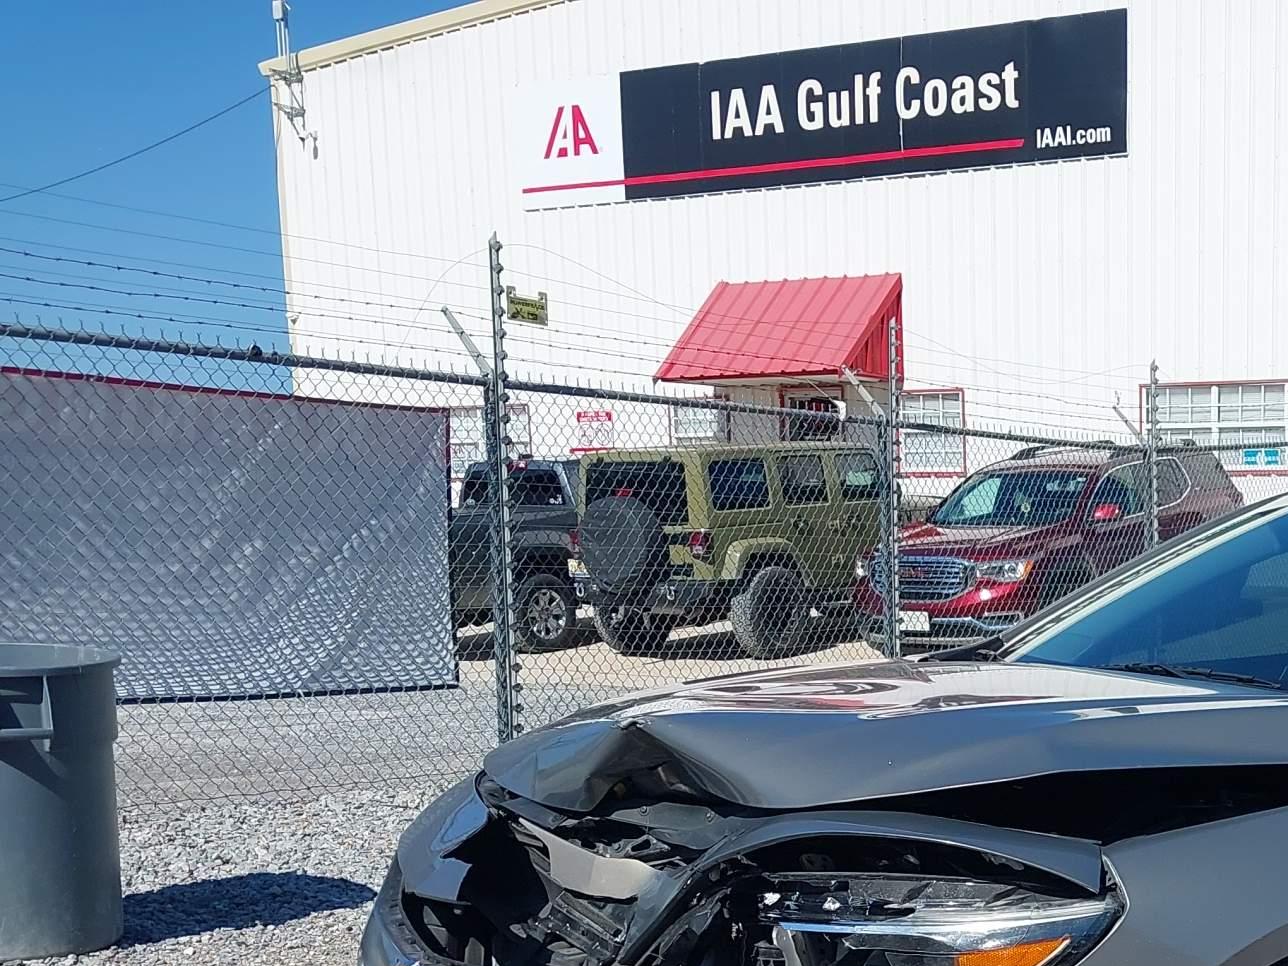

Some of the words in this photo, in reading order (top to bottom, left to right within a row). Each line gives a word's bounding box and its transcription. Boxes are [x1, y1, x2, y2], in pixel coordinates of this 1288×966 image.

[710, 84, 783, 140] IAA
[798, 71, 881, 129] Gulf
[894, 61, 1018, 118] Coast
[1035, 125, 1111, 149] IAAI.com
